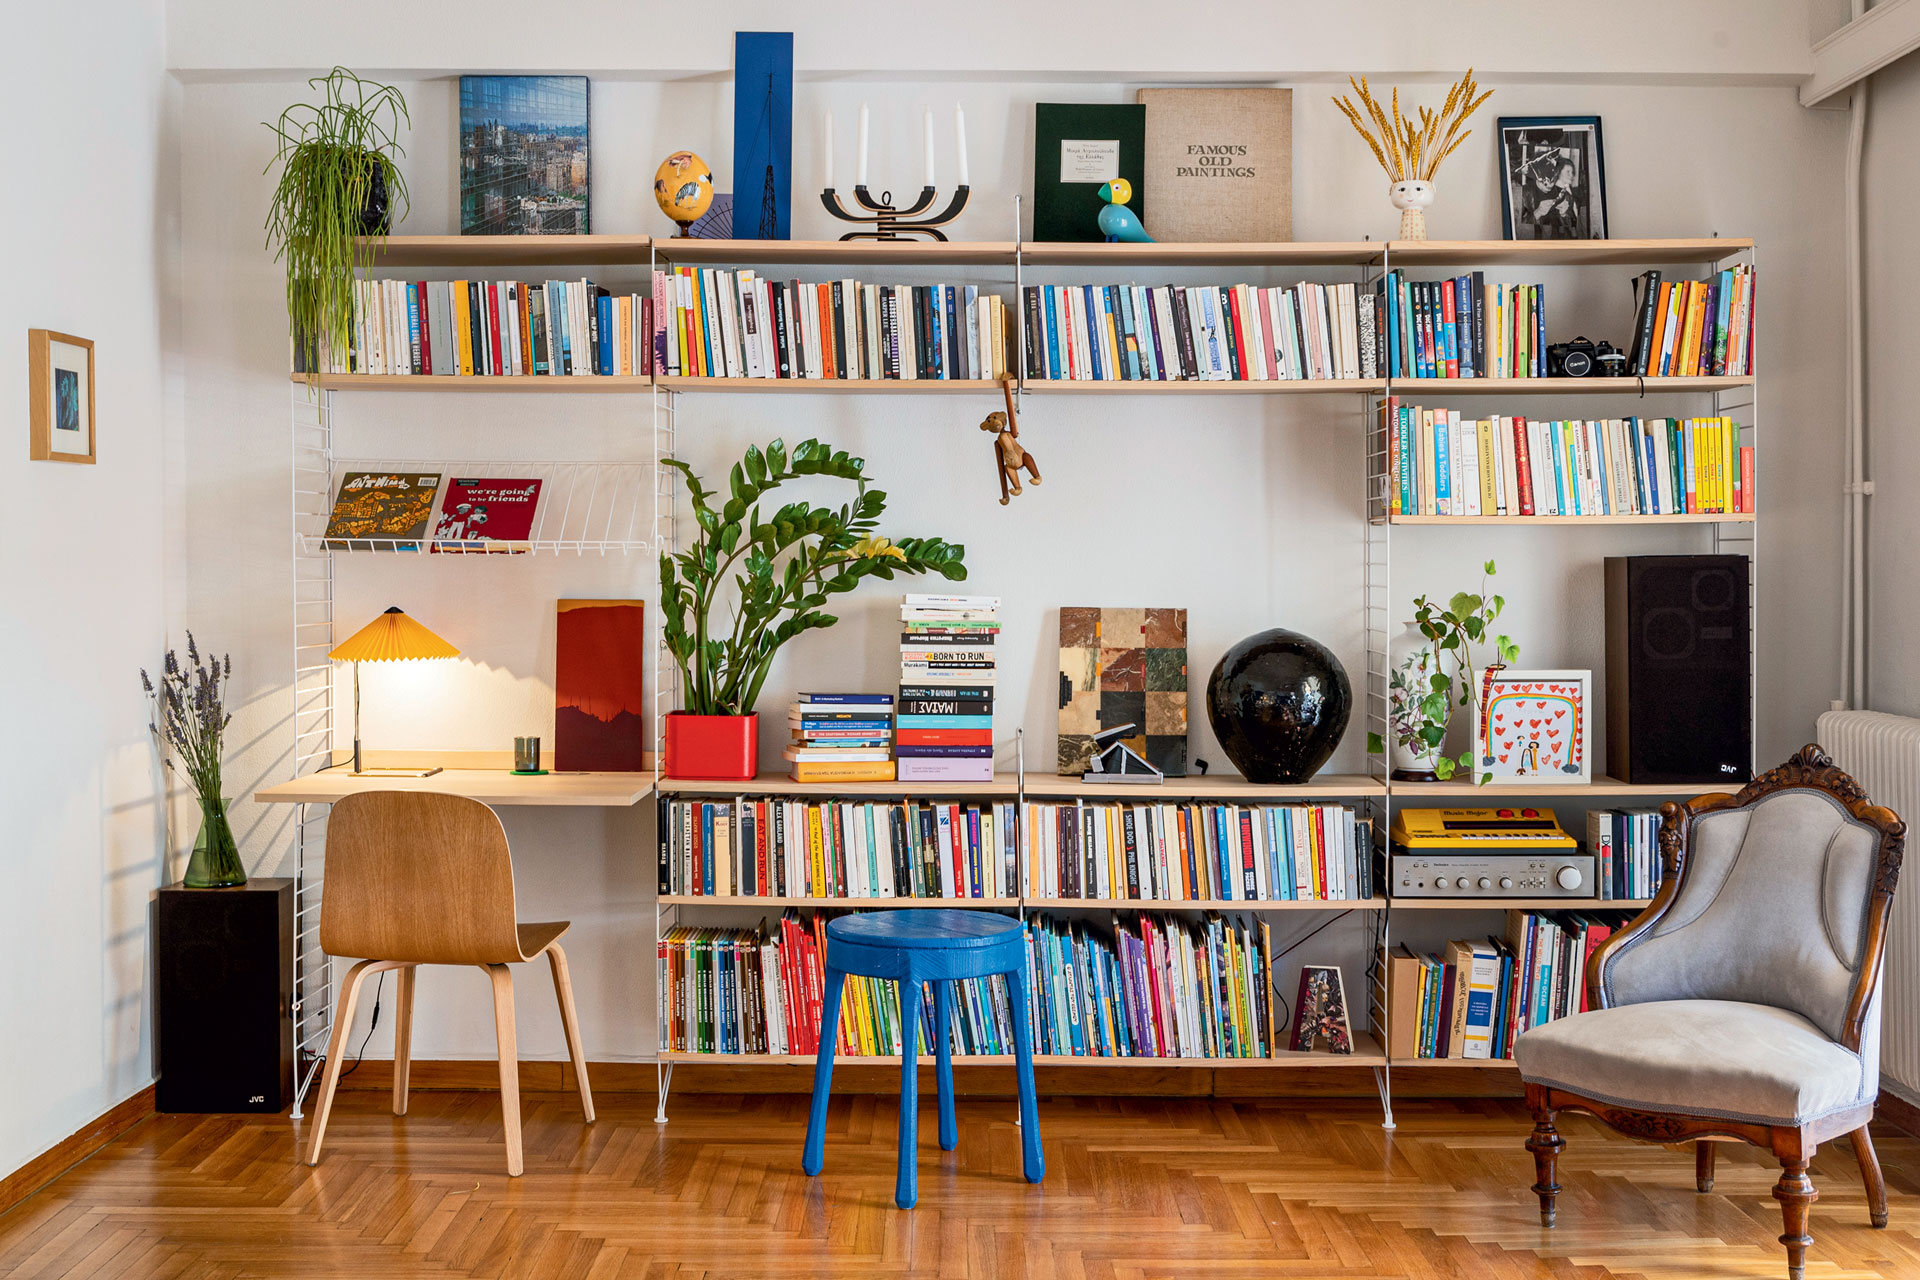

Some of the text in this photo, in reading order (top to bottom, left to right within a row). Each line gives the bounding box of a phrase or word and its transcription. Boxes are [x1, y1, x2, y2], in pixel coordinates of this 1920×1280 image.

[1187, 145, 1247, 156] FAMOUS
[1199, 156, 1232, 166] OLD
[1176, 167, 1256, 178] PAINTINGS
[410, 305, 419, 328] NATURAL
[411, 330, 420, 344] BORN
[412, 345, 421, 365] HEROES
[1438, 427, 1446, 452] Babies
[1439, 461, 1447, 491] Toddlers
[467, 488, 530, 498] we're going
[1720, 764, 1737, 774] JVC
[1125, 814, 1134, 830] SHOE
[1126, 831, 1134, 844] DOG
[1241, 825, 1253, 869] UNWINDING
[1129, 865, 1137, 885] KNIGHT
[248, 1095, 264, 1103] JVC
